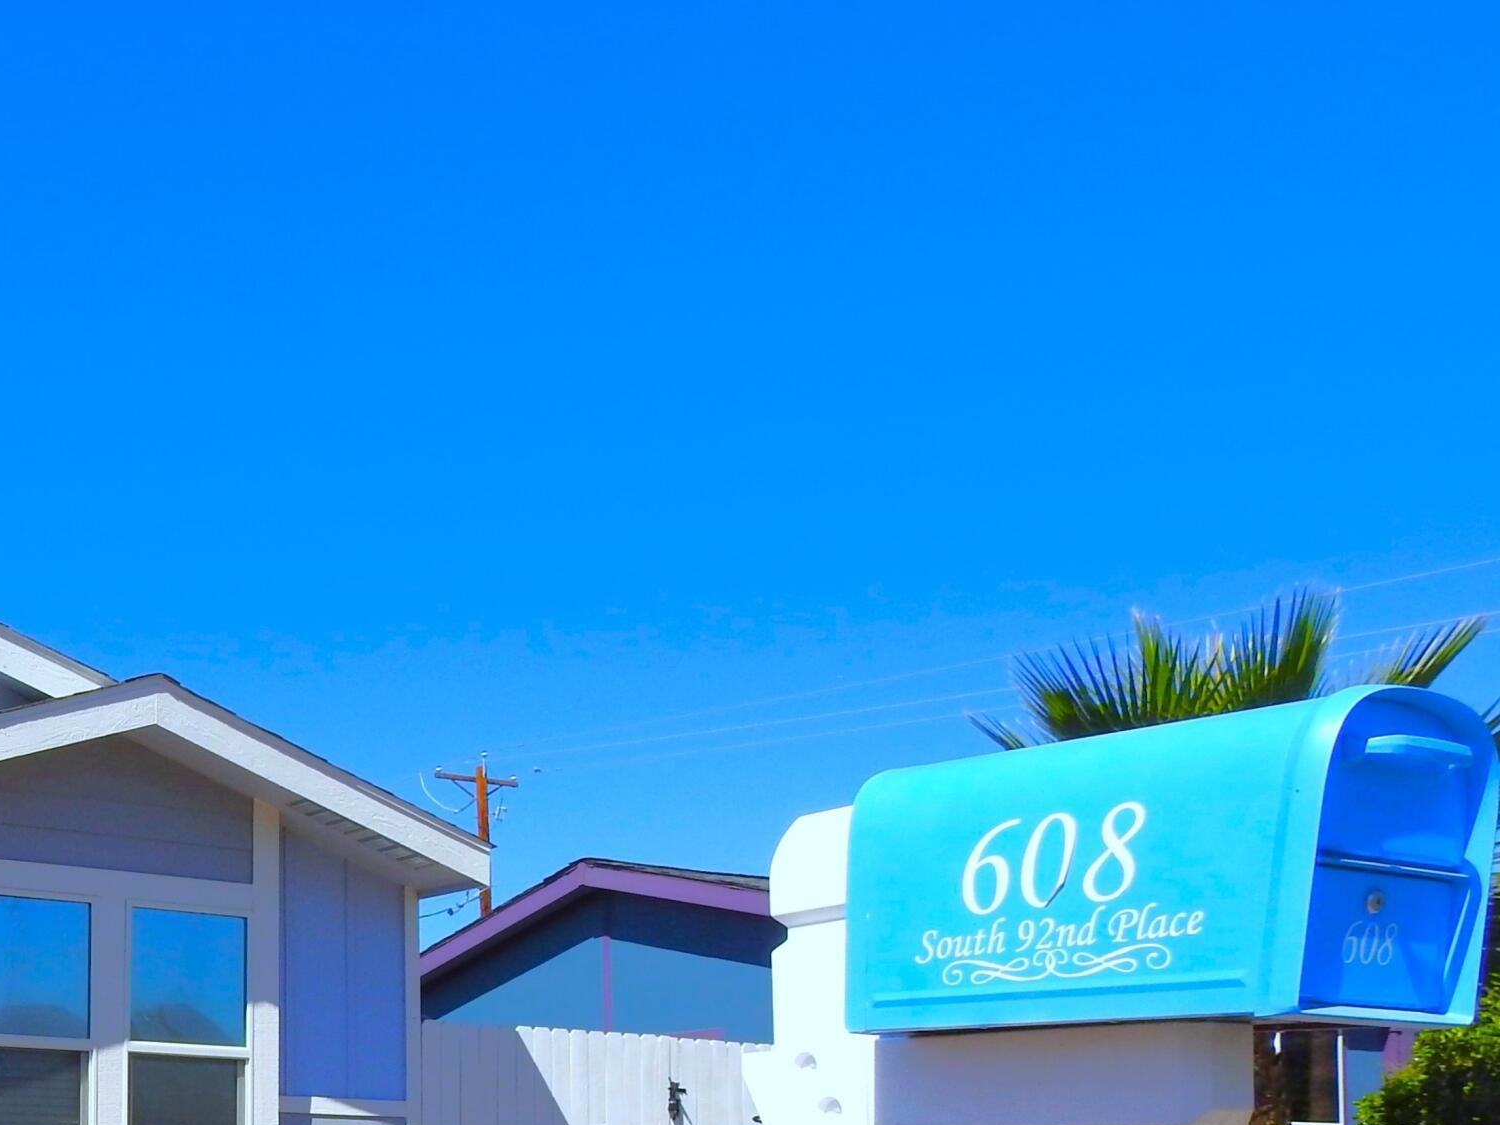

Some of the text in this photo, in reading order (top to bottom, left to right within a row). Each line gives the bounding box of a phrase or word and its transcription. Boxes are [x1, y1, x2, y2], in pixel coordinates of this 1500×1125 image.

[962, 801, 1146, 915] 608
[914, 902, 1204, 964] South 92nd Place
[1342, 920, 1398, 966] 608
